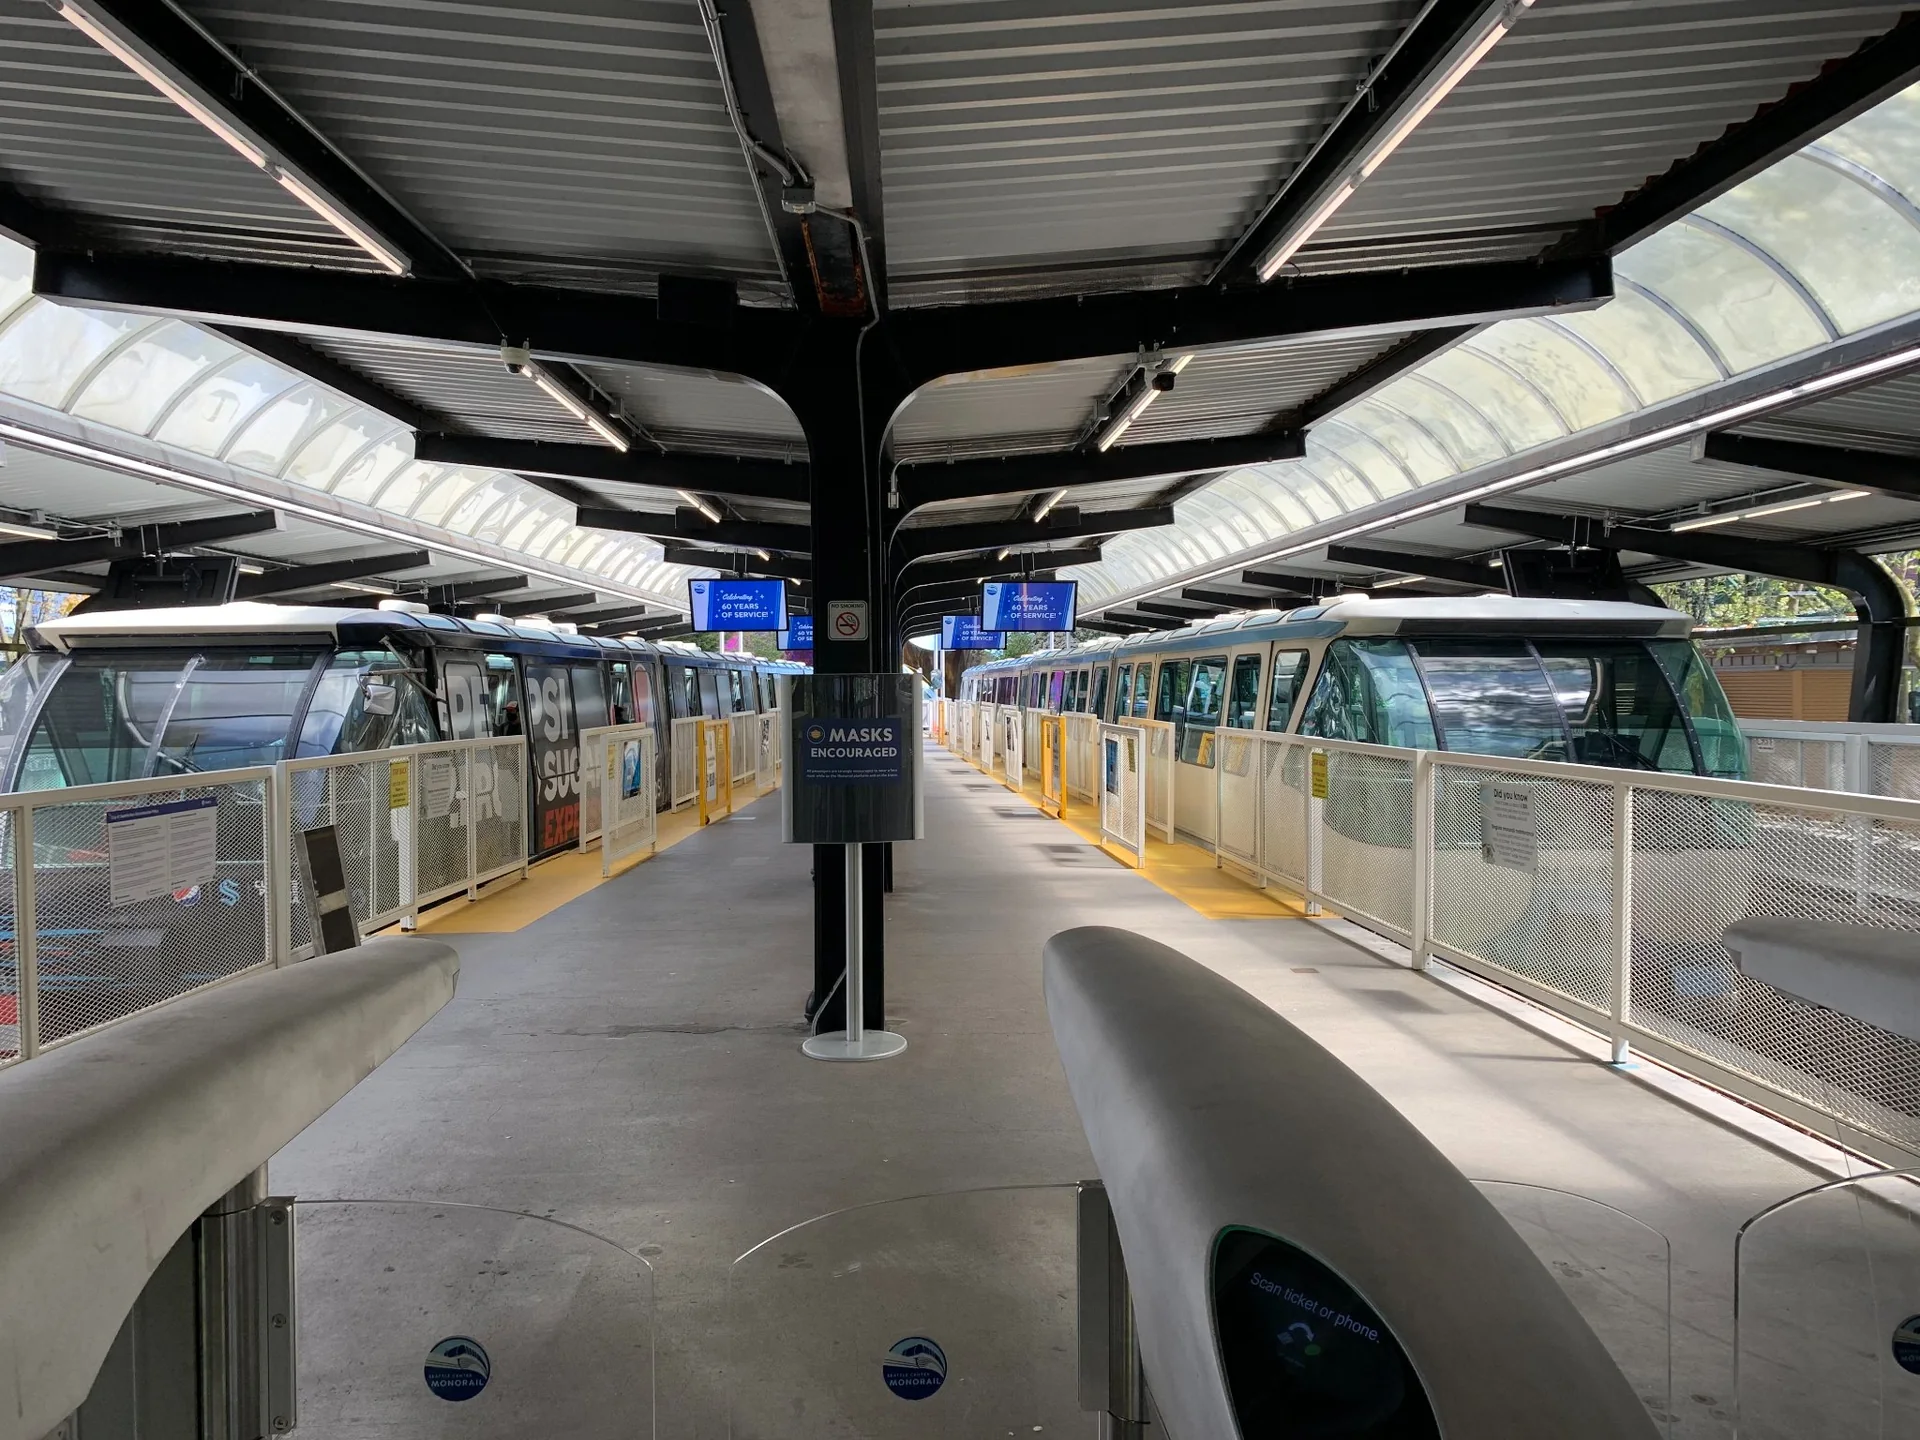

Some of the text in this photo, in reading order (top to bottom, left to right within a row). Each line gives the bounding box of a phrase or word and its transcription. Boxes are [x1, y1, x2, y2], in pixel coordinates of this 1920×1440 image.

[722, 593, 753, 602] Celebrating
[1013, 595, 1043, 603] Celebrating
[829, 727, 893, 742] MASKS
[811, 747, 898, 758] ENCOURAGED
[1493, 788, 1528, 802] Did you know
[1250, 1272, 1380, 1344] Scan ticket or phone.
[430, 1379, 484, 1387] MONORAIL
[889, 1378, 941, 1386] MONORAIL
